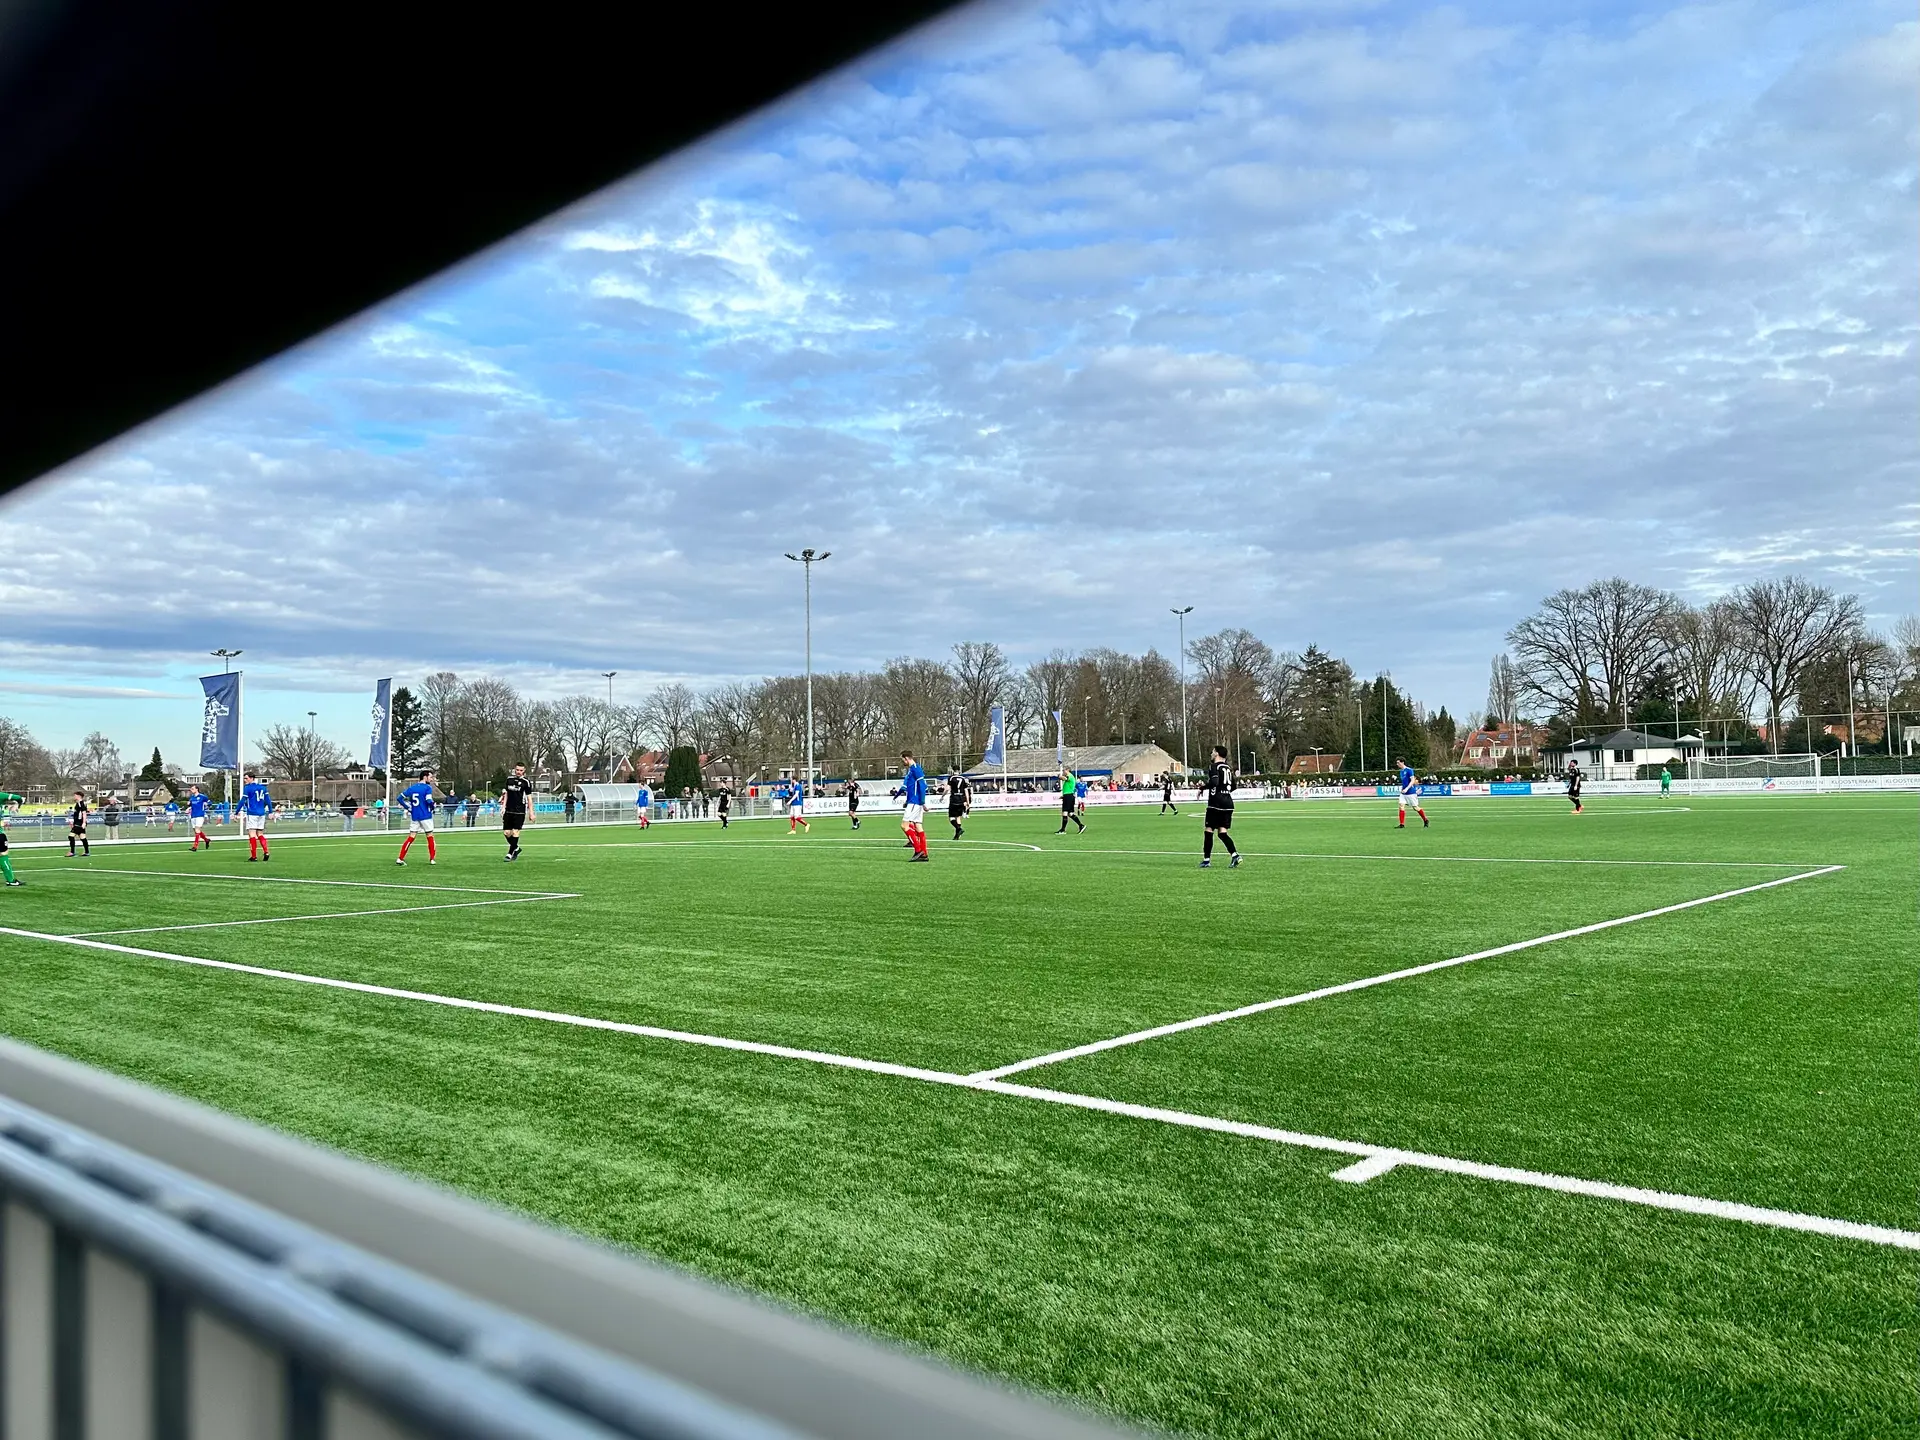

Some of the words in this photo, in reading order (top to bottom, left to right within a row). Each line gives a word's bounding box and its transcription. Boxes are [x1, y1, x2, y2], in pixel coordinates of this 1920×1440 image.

[1222, 767, 1233, 785] 10
[956, 778, 963, 790] 7
[255, 789, 265, 802] 14
[412, 793, 420, 807] 5
[818, 800, 849, 809] LEAPED
